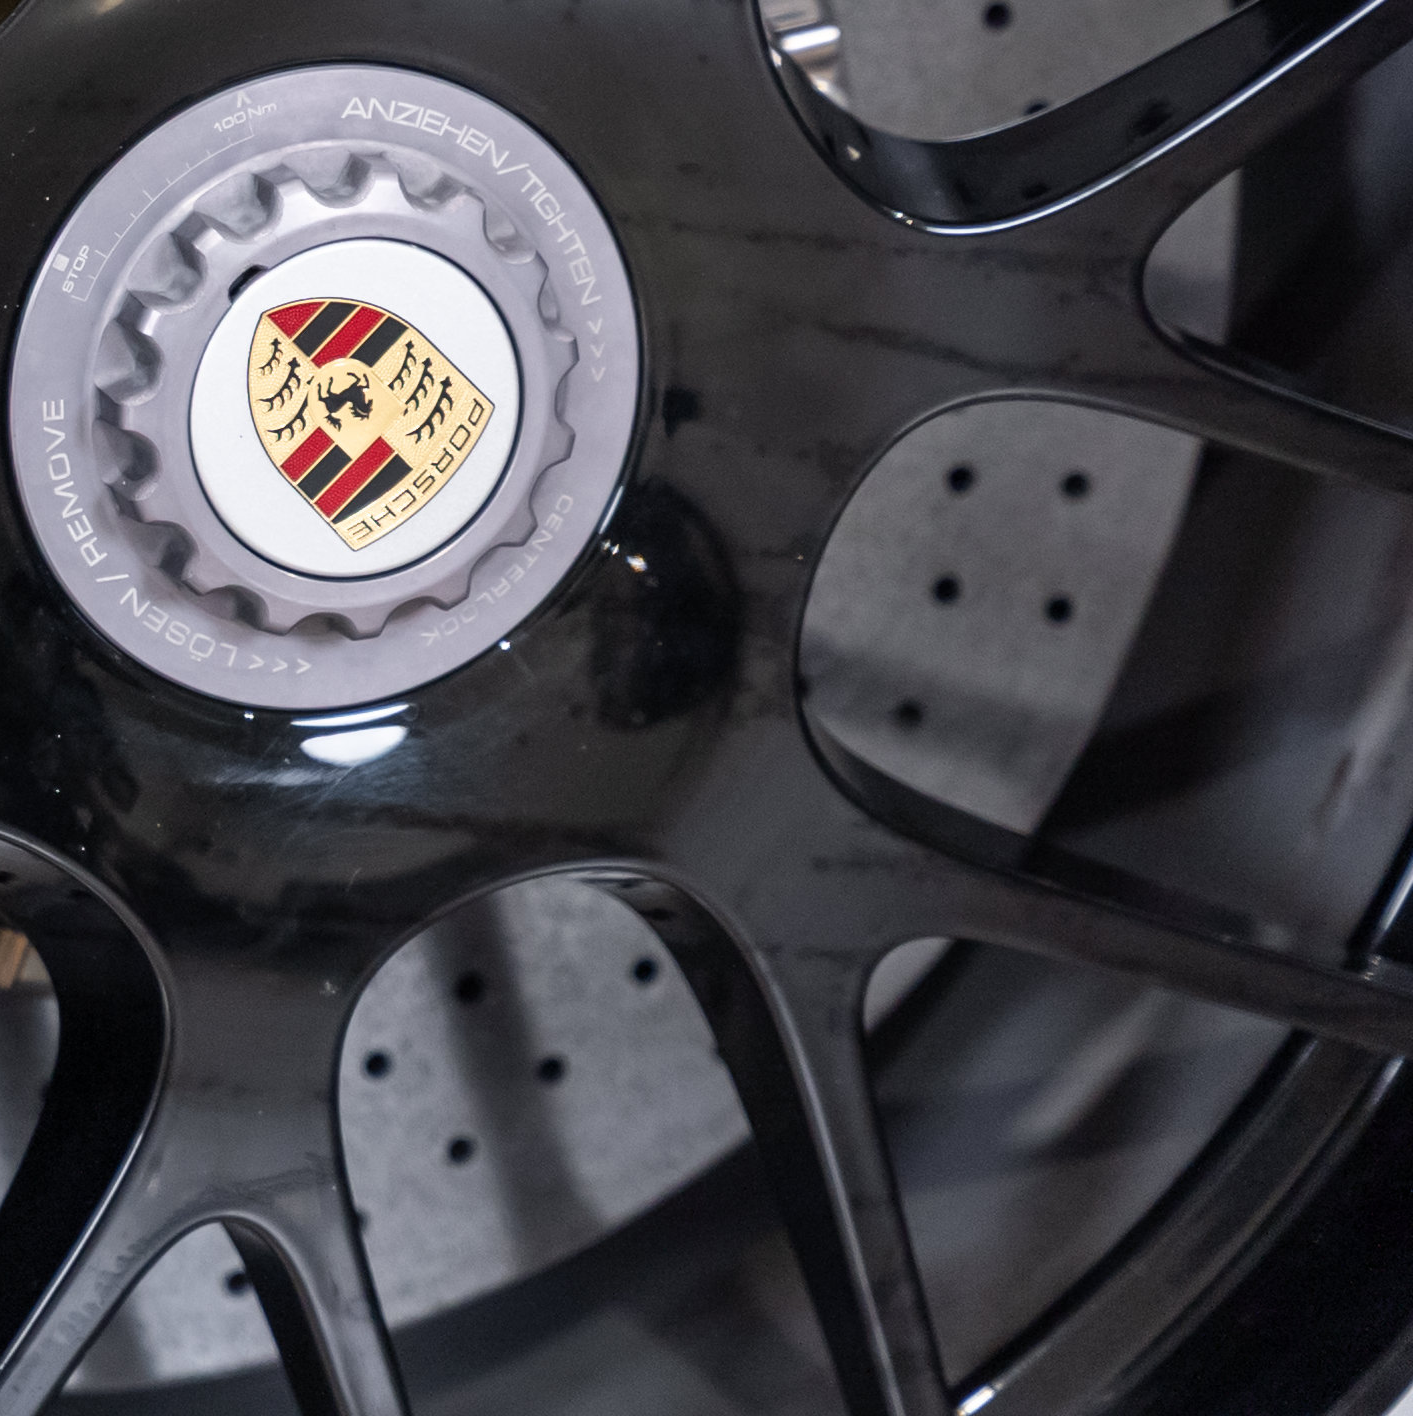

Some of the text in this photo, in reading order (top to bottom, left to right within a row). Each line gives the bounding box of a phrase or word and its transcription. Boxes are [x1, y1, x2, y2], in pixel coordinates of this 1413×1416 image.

[62, 244, 90, 293] STOP
[42, 399, 108, 567] REMOVE
[347, 398, 484, 540] PORSCHE
[120, 587, 238, 667] LÖSEN
[420, 494, 573, 646] CENTERLOCK
